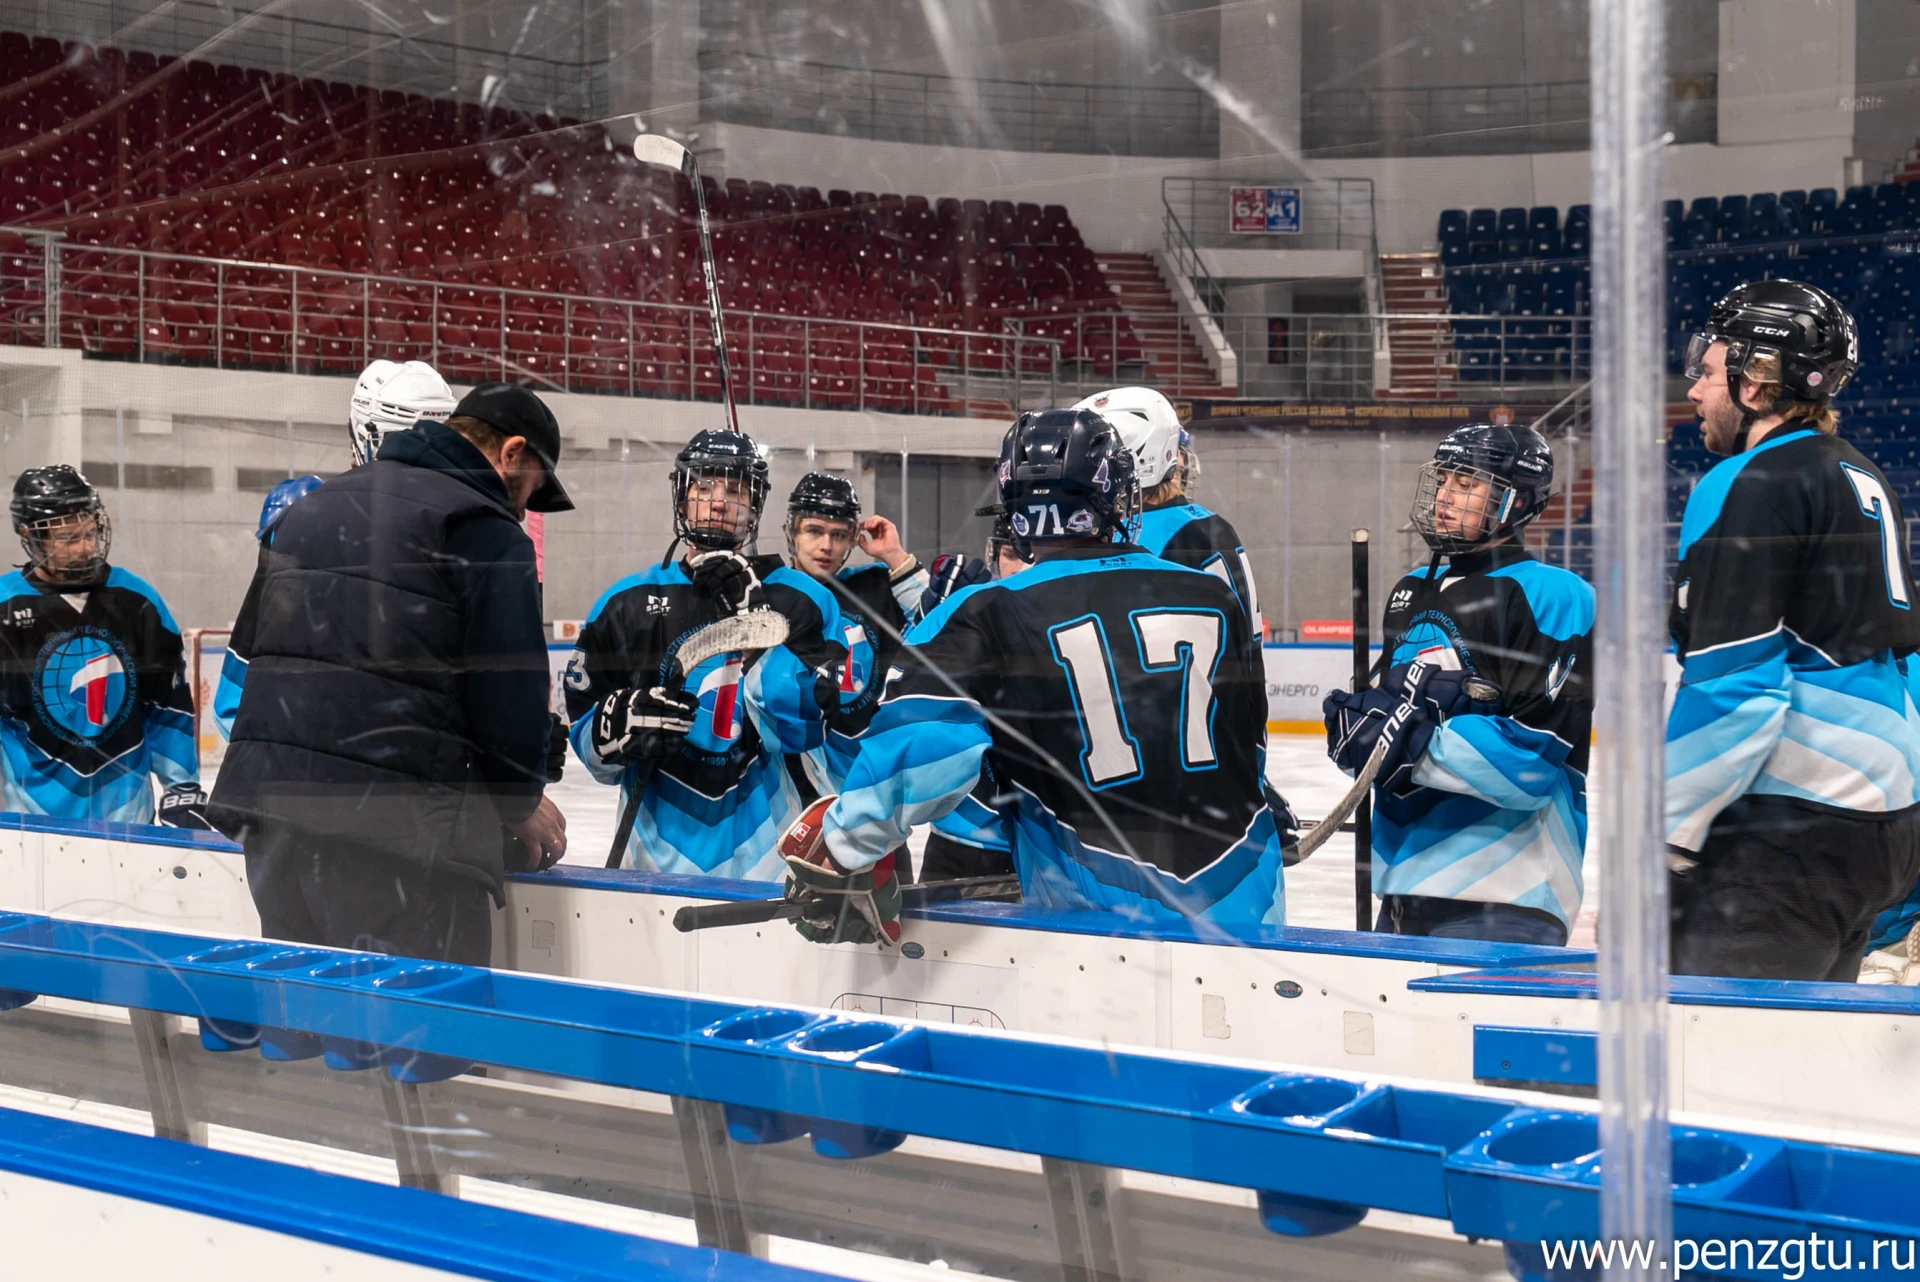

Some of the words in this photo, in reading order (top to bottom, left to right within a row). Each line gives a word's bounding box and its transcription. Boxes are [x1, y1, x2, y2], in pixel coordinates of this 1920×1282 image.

[1752, 325, 1791, 338] CCM
[1027, 503, 1065, 536] 71
[1303, 625, 1353, 635] OLIMPBE
[1047, 606, 1227, 792] 17
